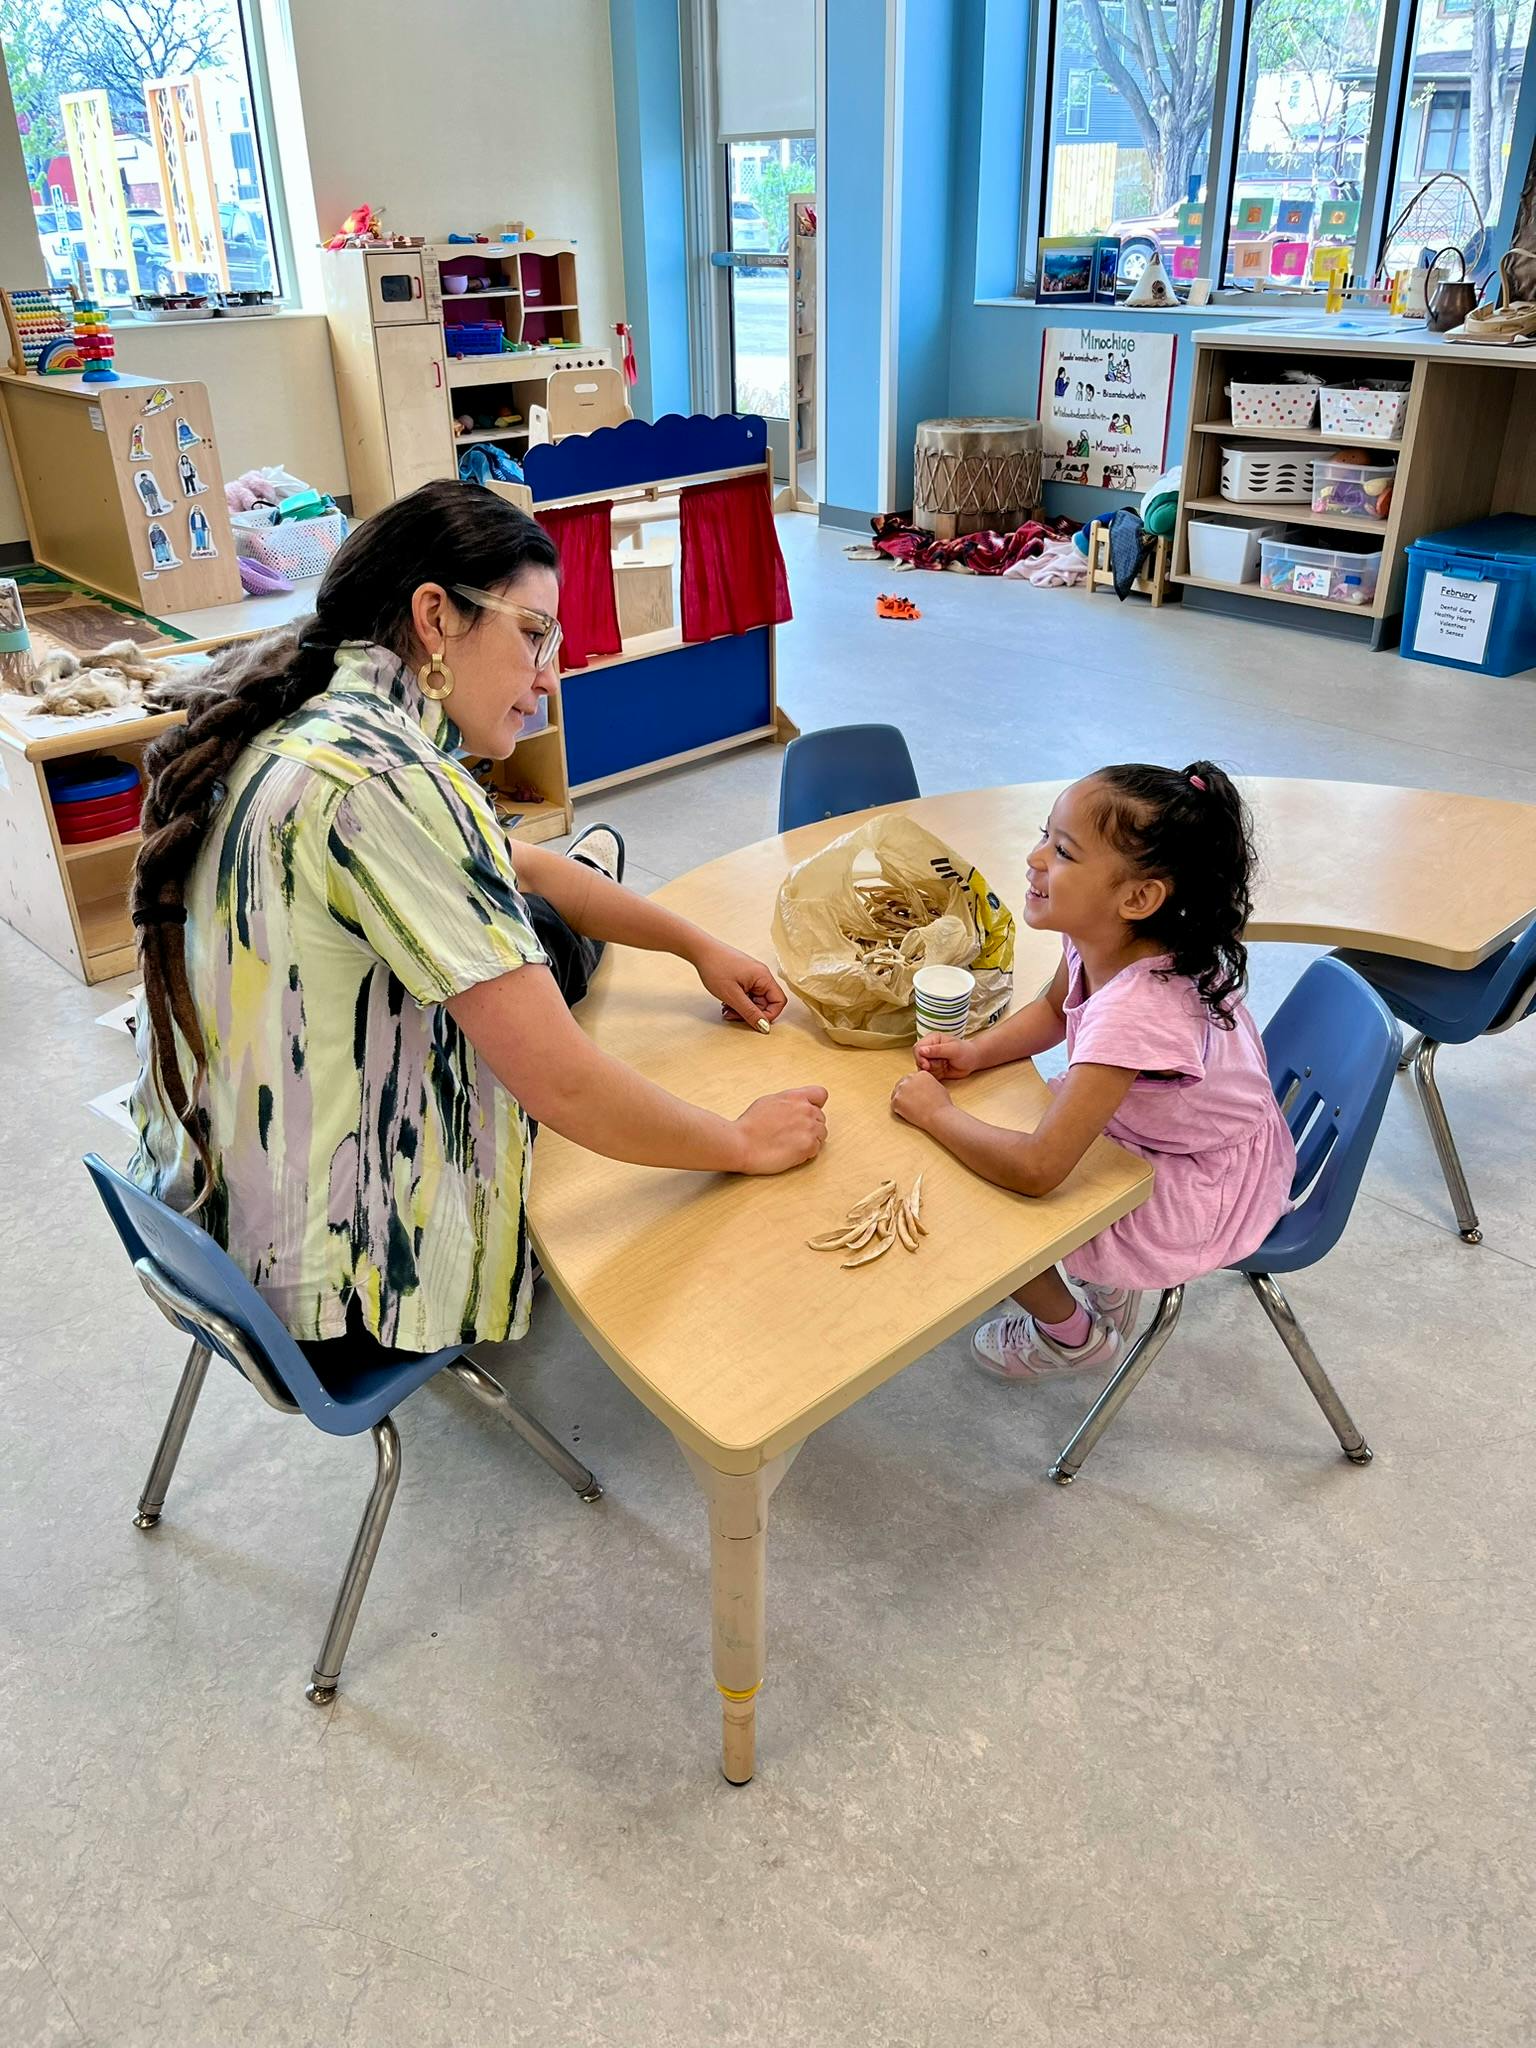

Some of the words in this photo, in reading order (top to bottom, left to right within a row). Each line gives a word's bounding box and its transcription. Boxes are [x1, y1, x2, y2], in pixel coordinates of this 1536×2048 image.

[1080, 329, 1136, 358] Minochige
[1440, 586, 1477, 601] February
[1440, 604, 1457, 612] Dental
[1434, 611, 1455, 620] Healthy
[1440, 620, 1467, 630] Valentines
[1445, 629, 1464, 637] Senses
